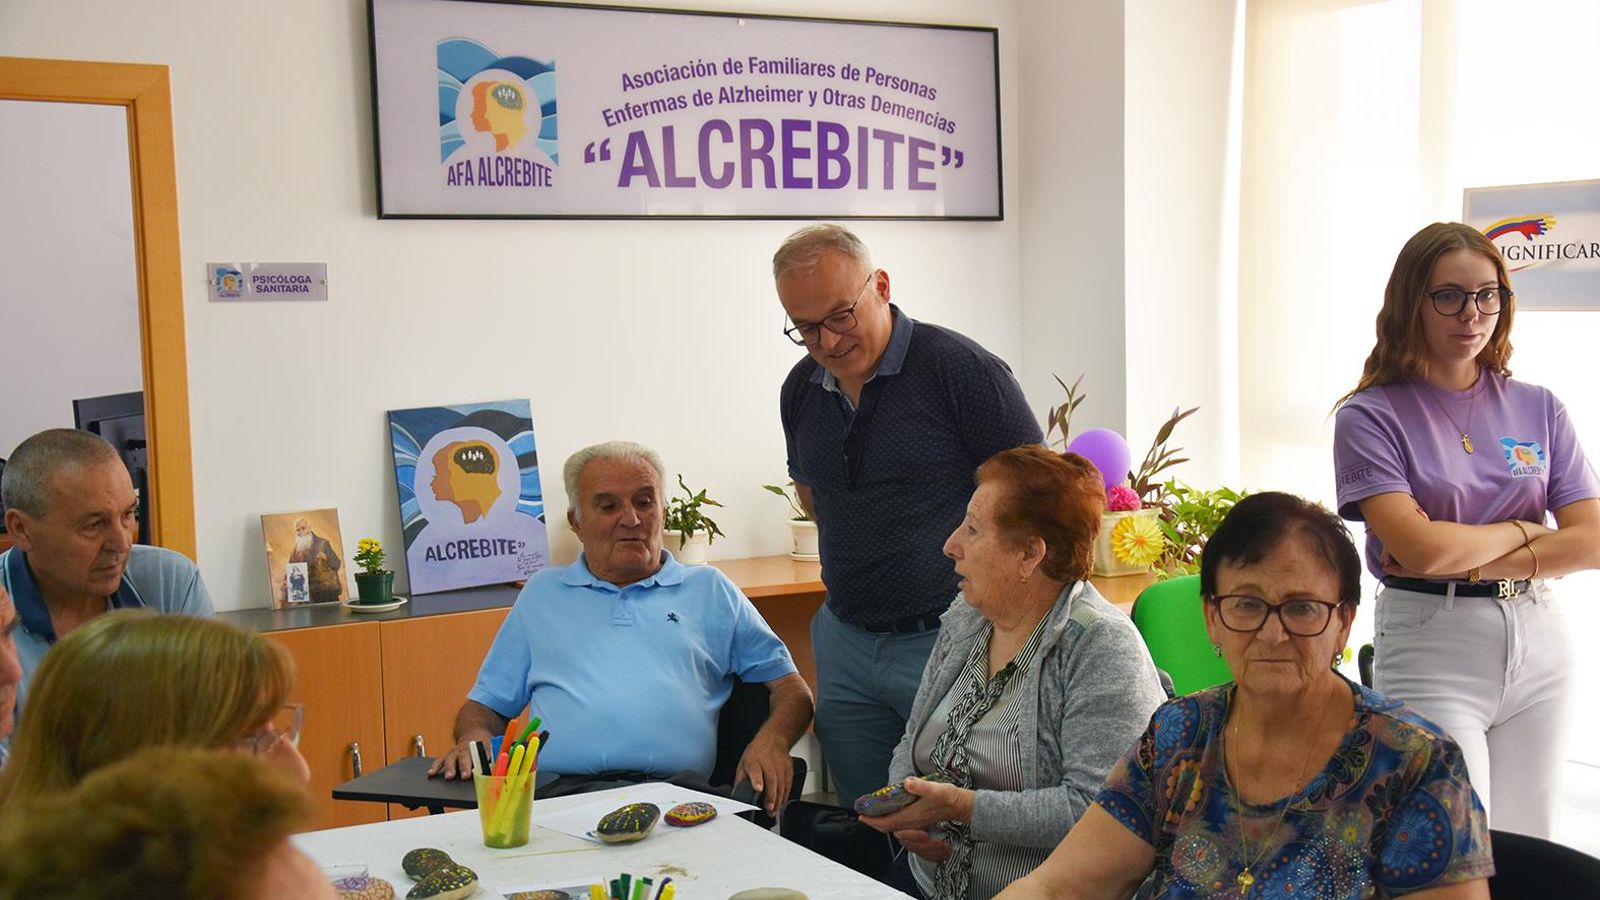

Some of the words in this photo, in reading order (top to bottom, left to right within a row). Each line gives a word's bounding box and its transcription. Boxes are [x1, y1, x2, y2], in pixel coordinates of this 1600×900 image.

[622, 59, 717, 92] Asociación
[722, 57, 743, 75] de
[749, 56, 836, 78] Familiares
[841, 64, 860, 82] de
[865, 67, 938, 101] Personas
[602, 94, 688, 127] Enfermas
[692, 89, 714, 107] de
[718, 85, 803, 104] Alzheimer
[808, 90, 818, 107] y
[823, 88, 866, 109] Otras
[871, 95, 956, 134] Demencias
[447, 159, 474, 186] AFA
[478, 156, 553, 187] ALCREBITE
[1501, 242, 1600, 261] IGNIFICAR
[252, 274, 312, 284] PSICÓLOGA
[256, 284, 310, 293] SANITARIA
